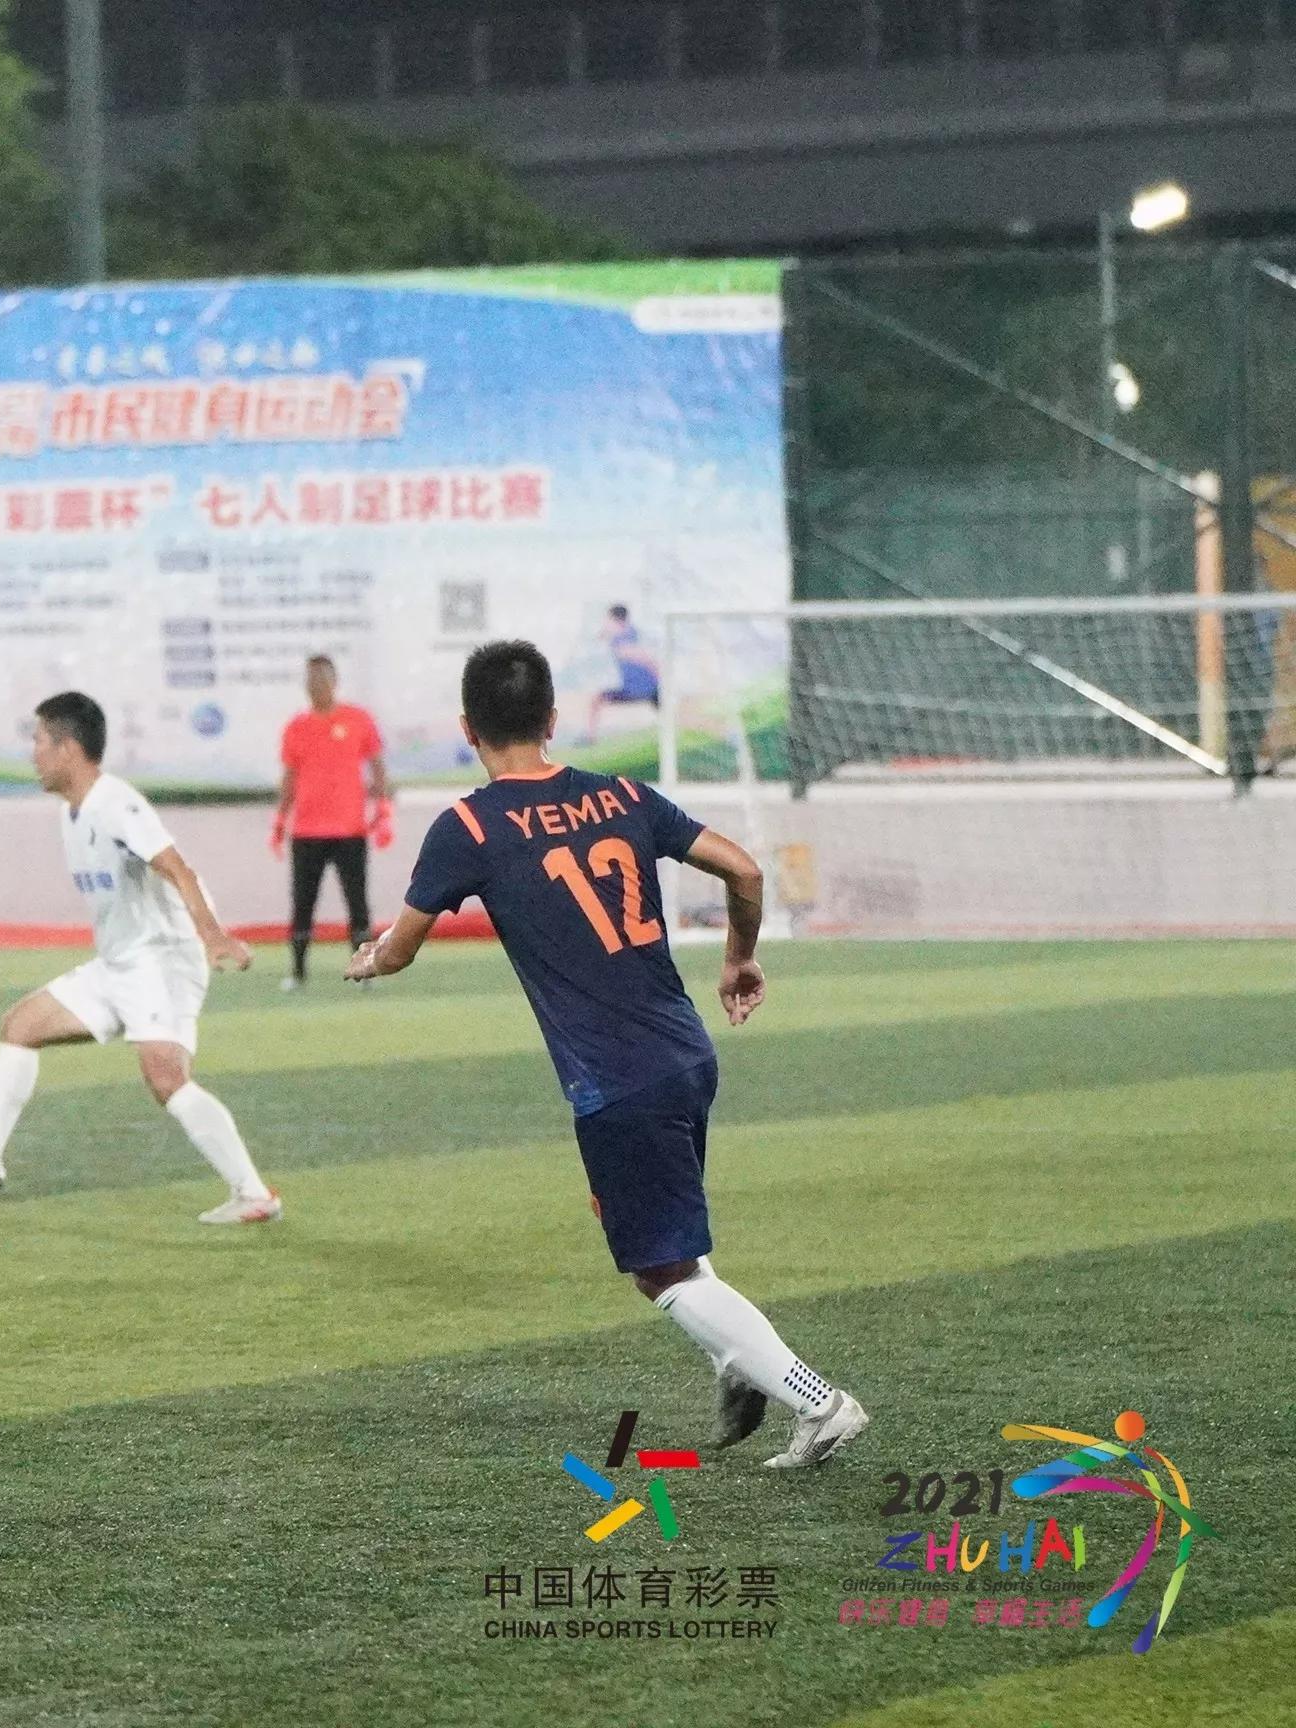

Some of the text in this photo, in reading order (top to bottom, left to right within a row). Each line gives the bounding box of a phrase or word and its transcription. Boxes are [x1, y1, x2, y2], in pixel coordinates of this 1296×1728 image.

[200, 473, 544, 527] 七人制足球比赛
[506, 789, 627, 839] YEMA
[542, 837, 662, 955] 12
